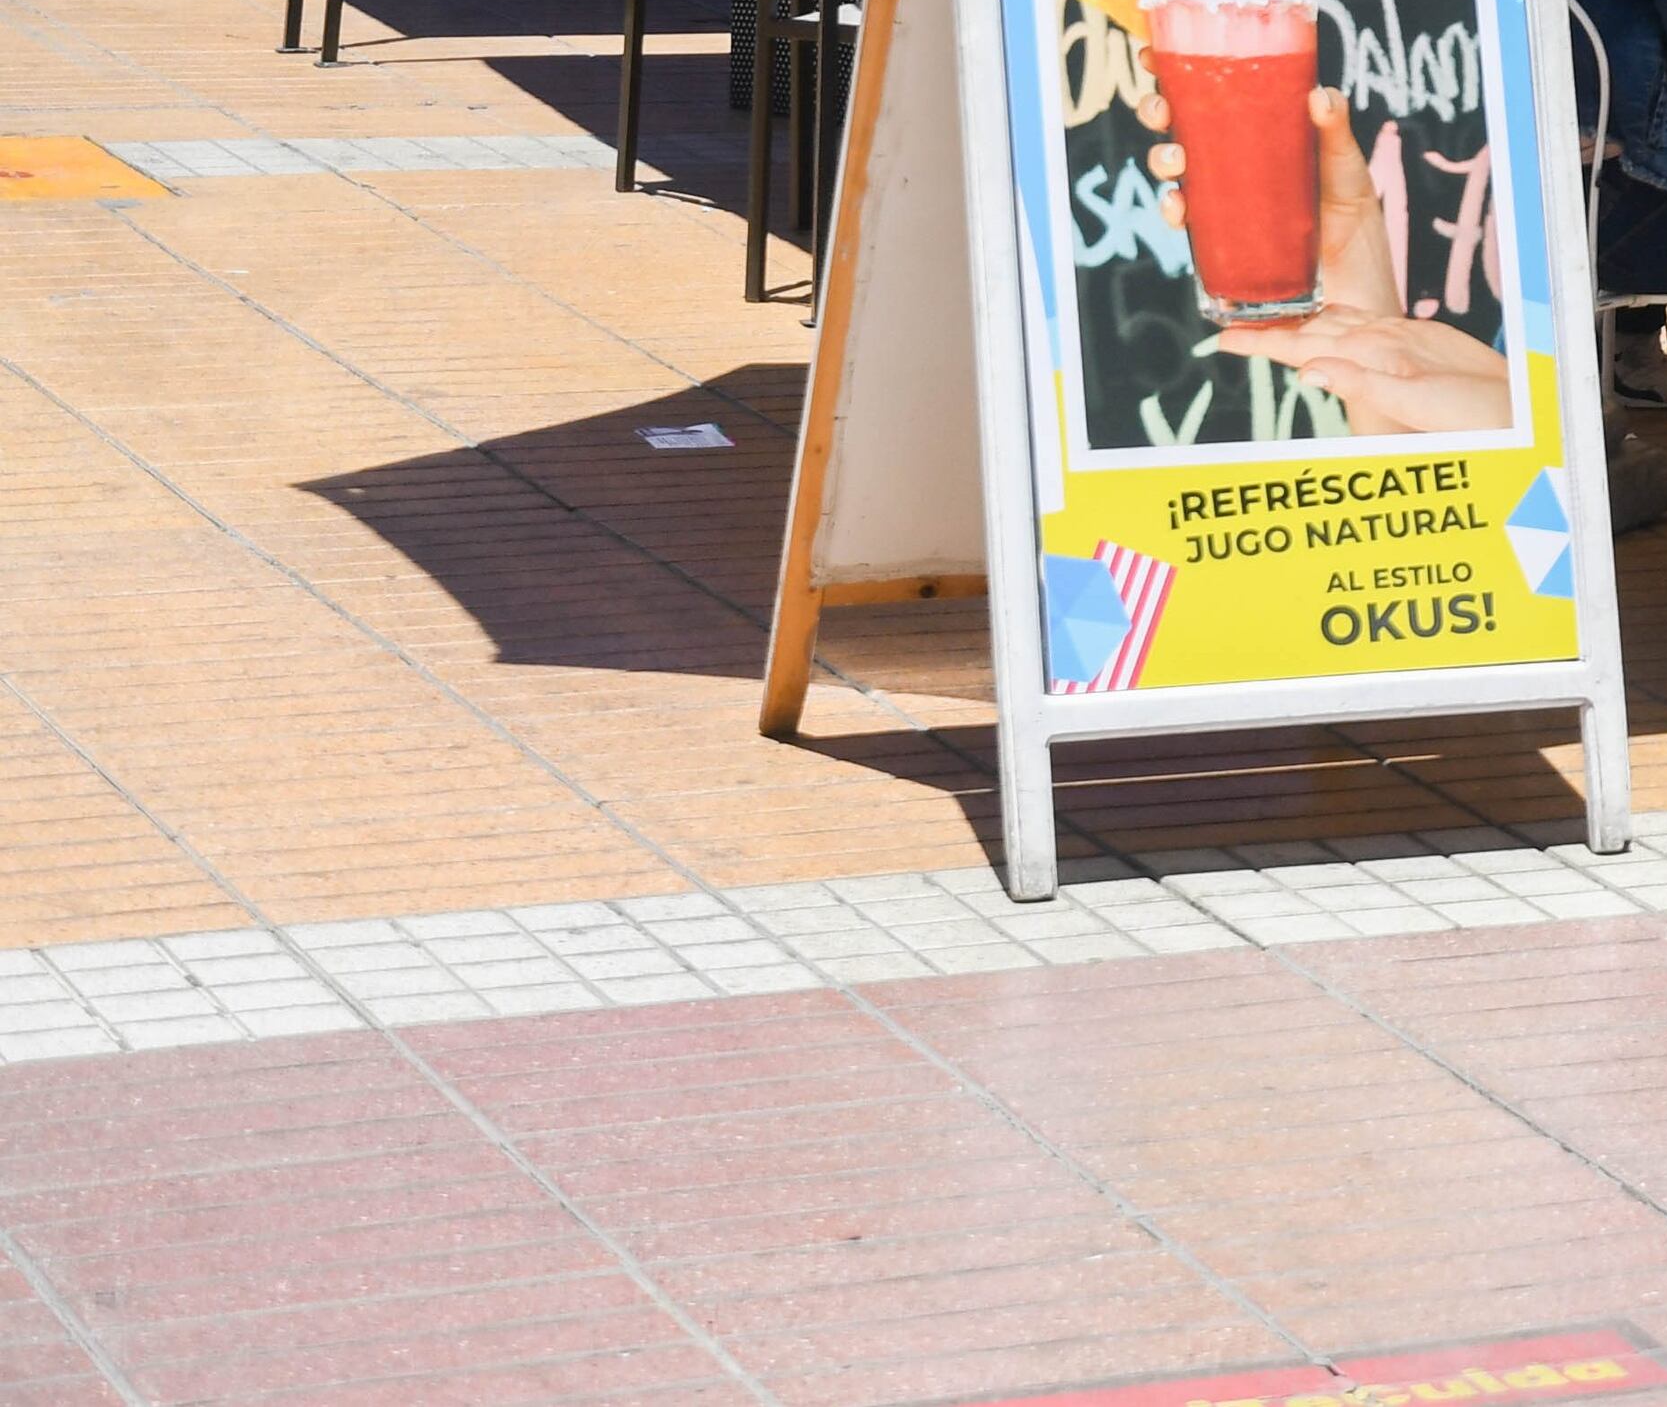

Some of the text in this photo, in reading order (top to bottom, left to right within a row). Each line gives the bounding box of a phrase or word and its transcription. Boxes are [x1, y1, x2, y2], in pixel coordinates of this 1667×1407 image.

[1167, 459, 1471, 531] ¡REFRÉSCATE!
[1186, 503, 1488, 564] JUGO NATURAL
[1326, 561, 1474, 593] AL ESTILO
[1320, 591, 1497, 646] OKUS!
